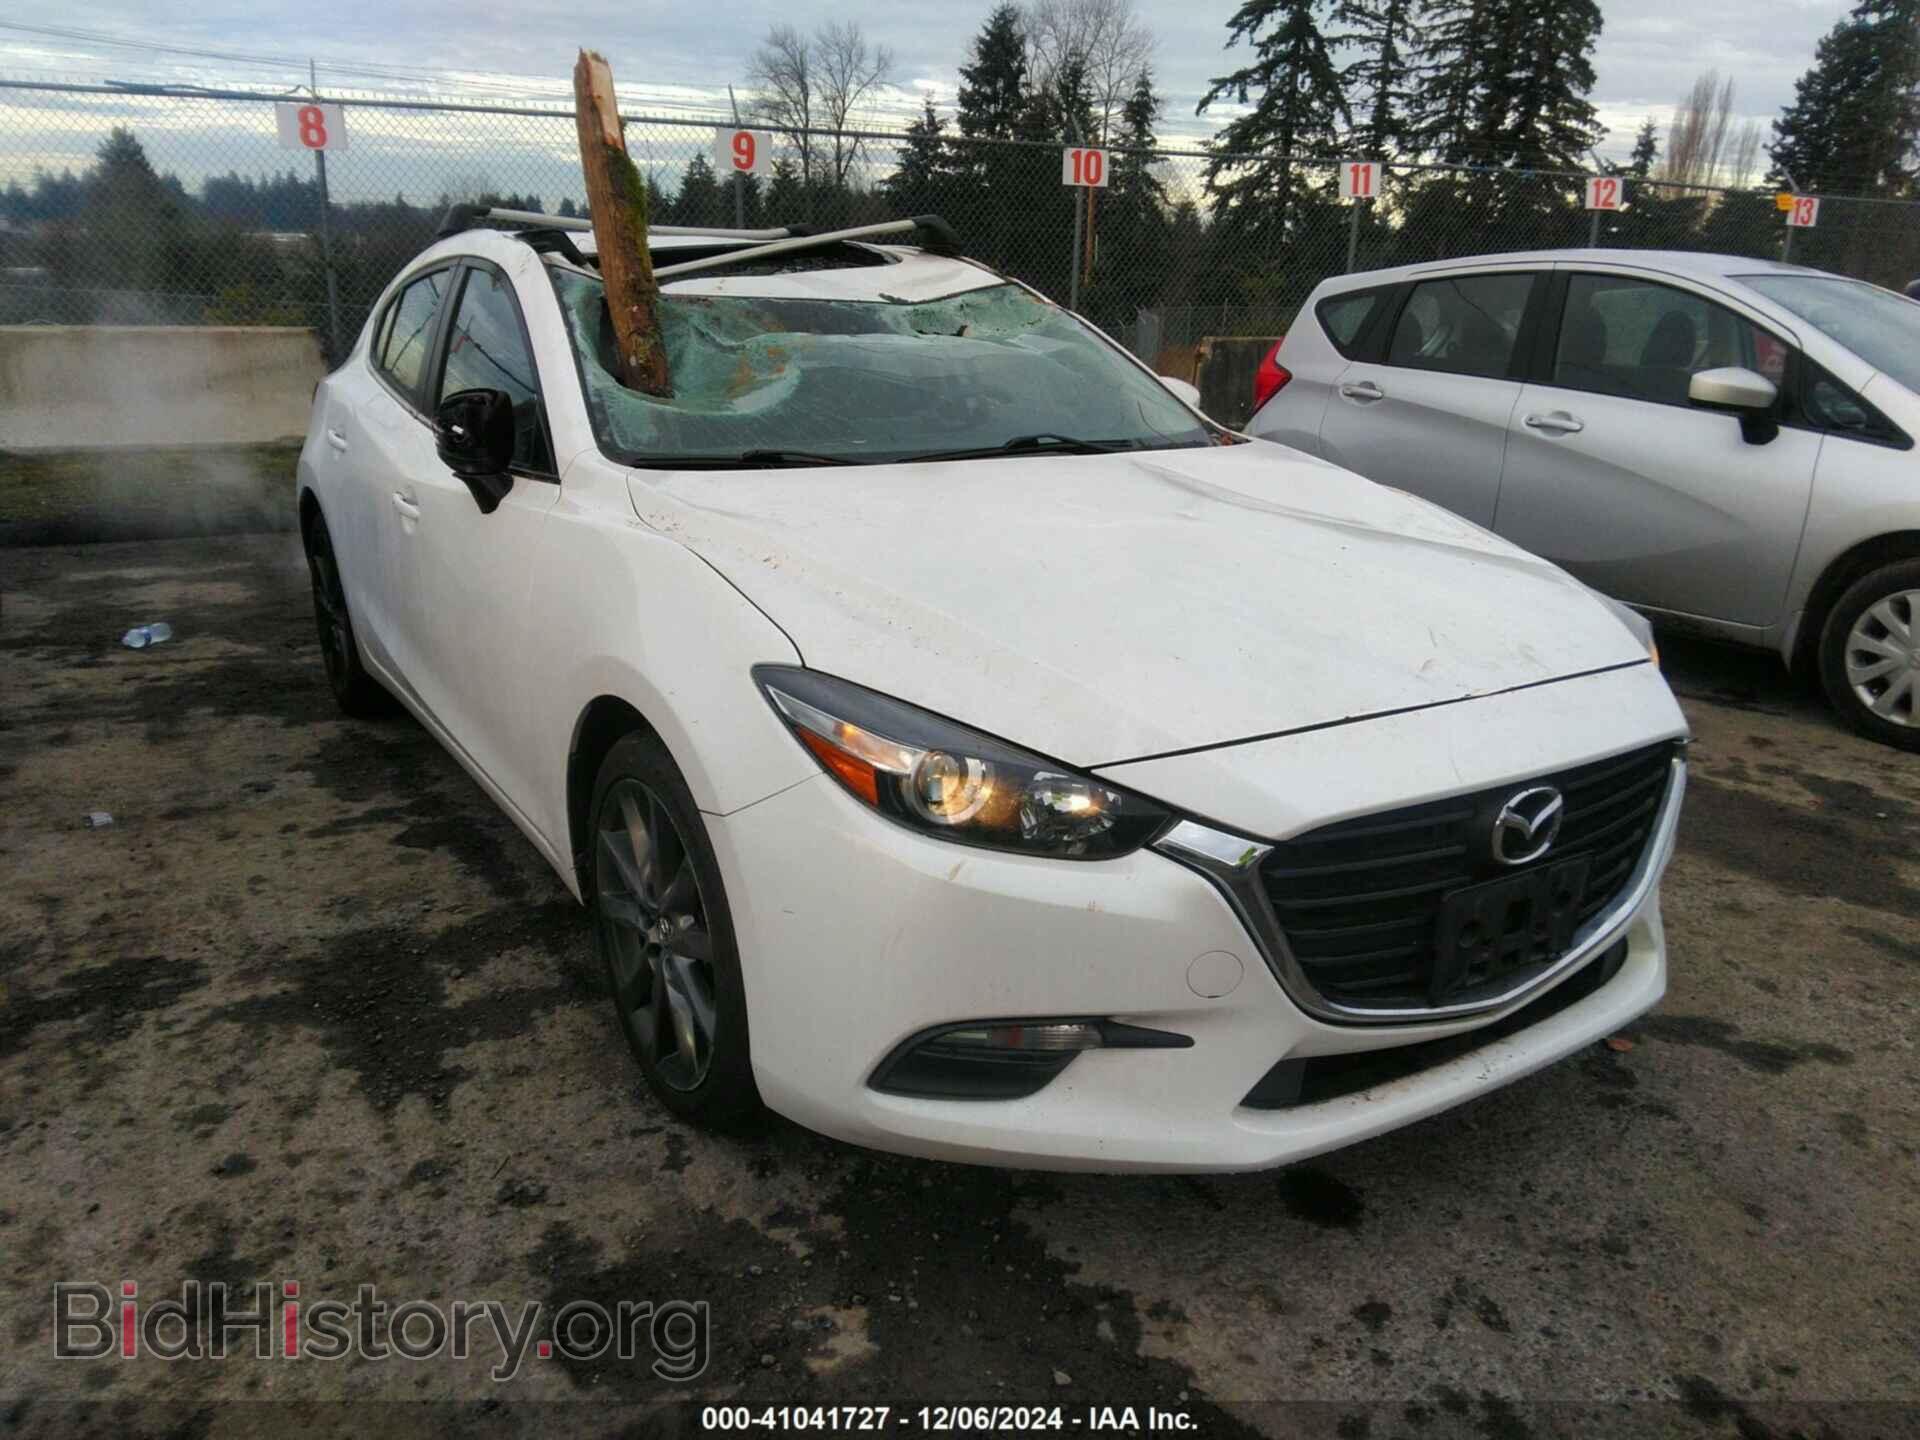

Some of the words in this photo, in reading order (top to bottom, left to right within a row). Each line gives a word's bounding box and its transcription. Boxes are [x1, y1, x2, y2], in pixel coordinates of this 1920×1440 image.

[300, 105, 328, 149] 8
[731, 131, 756, 170] 9
[1071, 149, 1102, 186] 10
[1350, 163, 1372, 195] 11
[1592, 178, 1617, 209] 12
[1792, 197, 1815, 226] 13
